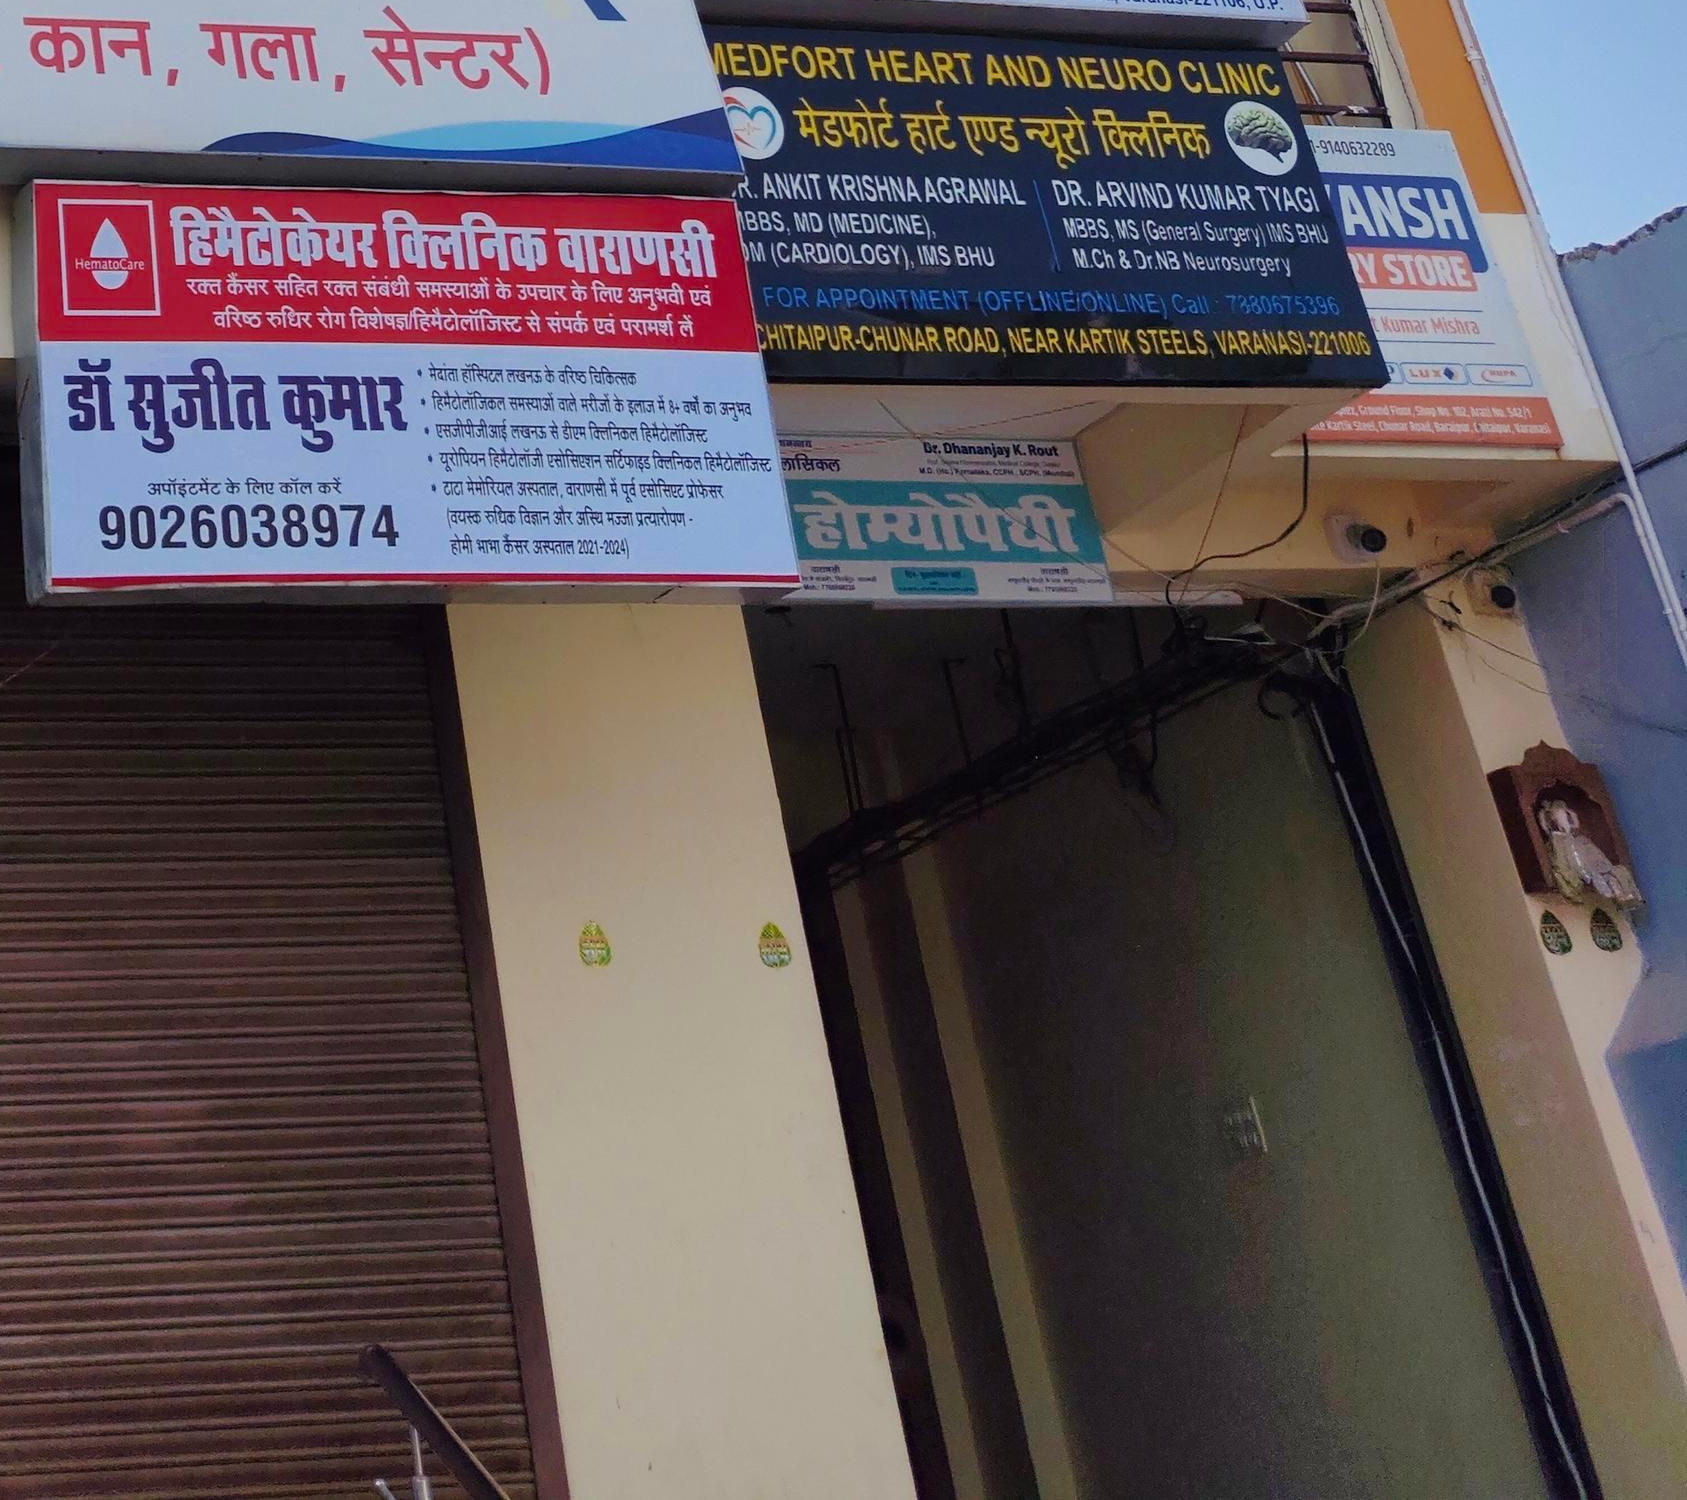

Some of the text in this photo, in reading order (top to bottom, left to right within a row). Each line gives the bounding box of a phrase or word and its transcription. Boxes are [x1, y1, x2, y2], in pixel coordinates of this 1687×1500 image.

[361, 5, 550, 97] सेन्टर)
[865, 49, 974, 84] HEART
[986, 54, 1052, 88] AND
[1057, 57, 1173, 93] NEURO
[1178, 60, 1281, 96] CLINIC
[792, 96, 1210, 169] मेडफोर्ट हार्ट एण्ड न्यूरो क्लिनिक
[763, 173, 1027, 206] ANKIT KRISHNA AGRAWAL
[1051, 179, 1320, 213] DR. ARVIND KUMAR TYAGI
[794, 213, 936, 240] MD (MEDICINE),
[1325, 183, 1469, 240] ANSH
[169, 206, 718, 278] हिमैटोकेयर क्लिनिक वाराणसी
[1062, 217, 1329, 247] MBBS, MS (General Surgery) IMS BHU
[75, 258, 145, 271] HematoCare
[771, 242, 996, 270] (CARDIOLOGY), IMS BHU
[1184, 252, 1291, 277] Neurosurgery
[1382, 255, 1473, 287] STORE
[186, 272, 712, 312] रक्त कैंसर सहित रक्त संबंधी समस्याओं के उपचार के लिए अनुभवी एवं
[762, 287, 809, 309] FOR
[816, 288, 970, 311] APPOINTMENT
[1172, 294, 1209, 315] Call
[214, 305, 262, 328] वरिष्ठ
[266, 308, 313, 329] रुधिर
[317, 306, 346, 330] रोग
[525, 309, 542, 333] से
[546, 312, 589, 335] संपर्क
[593, 312, 617, 335] एवं
[621, 313, 674, 338] परामर्श
[679, 314, 694, 338] लें
[1382, 316, 1480, 334] Kumar Mishra
[944, 327, 1007, 357] ROAD,
[1010, 327, 1062, 354] NEAR
[1065, 328, 1133, 354] KARTIK
[1137, 329, 1215, 358] STEELS,
[461, 364, 504, 384] हॉस्पिटल
[506, 369, 542, 384] लखनऊ
[544, 365, 554, 384] के
[558, 365, 587, 385] वरिष्ठ
[589, 366, 637, 386] चिकित्सक
[64, 358, 408, 454] डॉ सुजीत कुमार
[943, 442, 1059, 457] Dhananjay Rout
[147, 477, 342, 497] अपॉइंटमेंट के लिए कॉल करें
[99, 504, 399, 550] 9026038974
[794, 491, 1078, 552] होम्योपैथी
